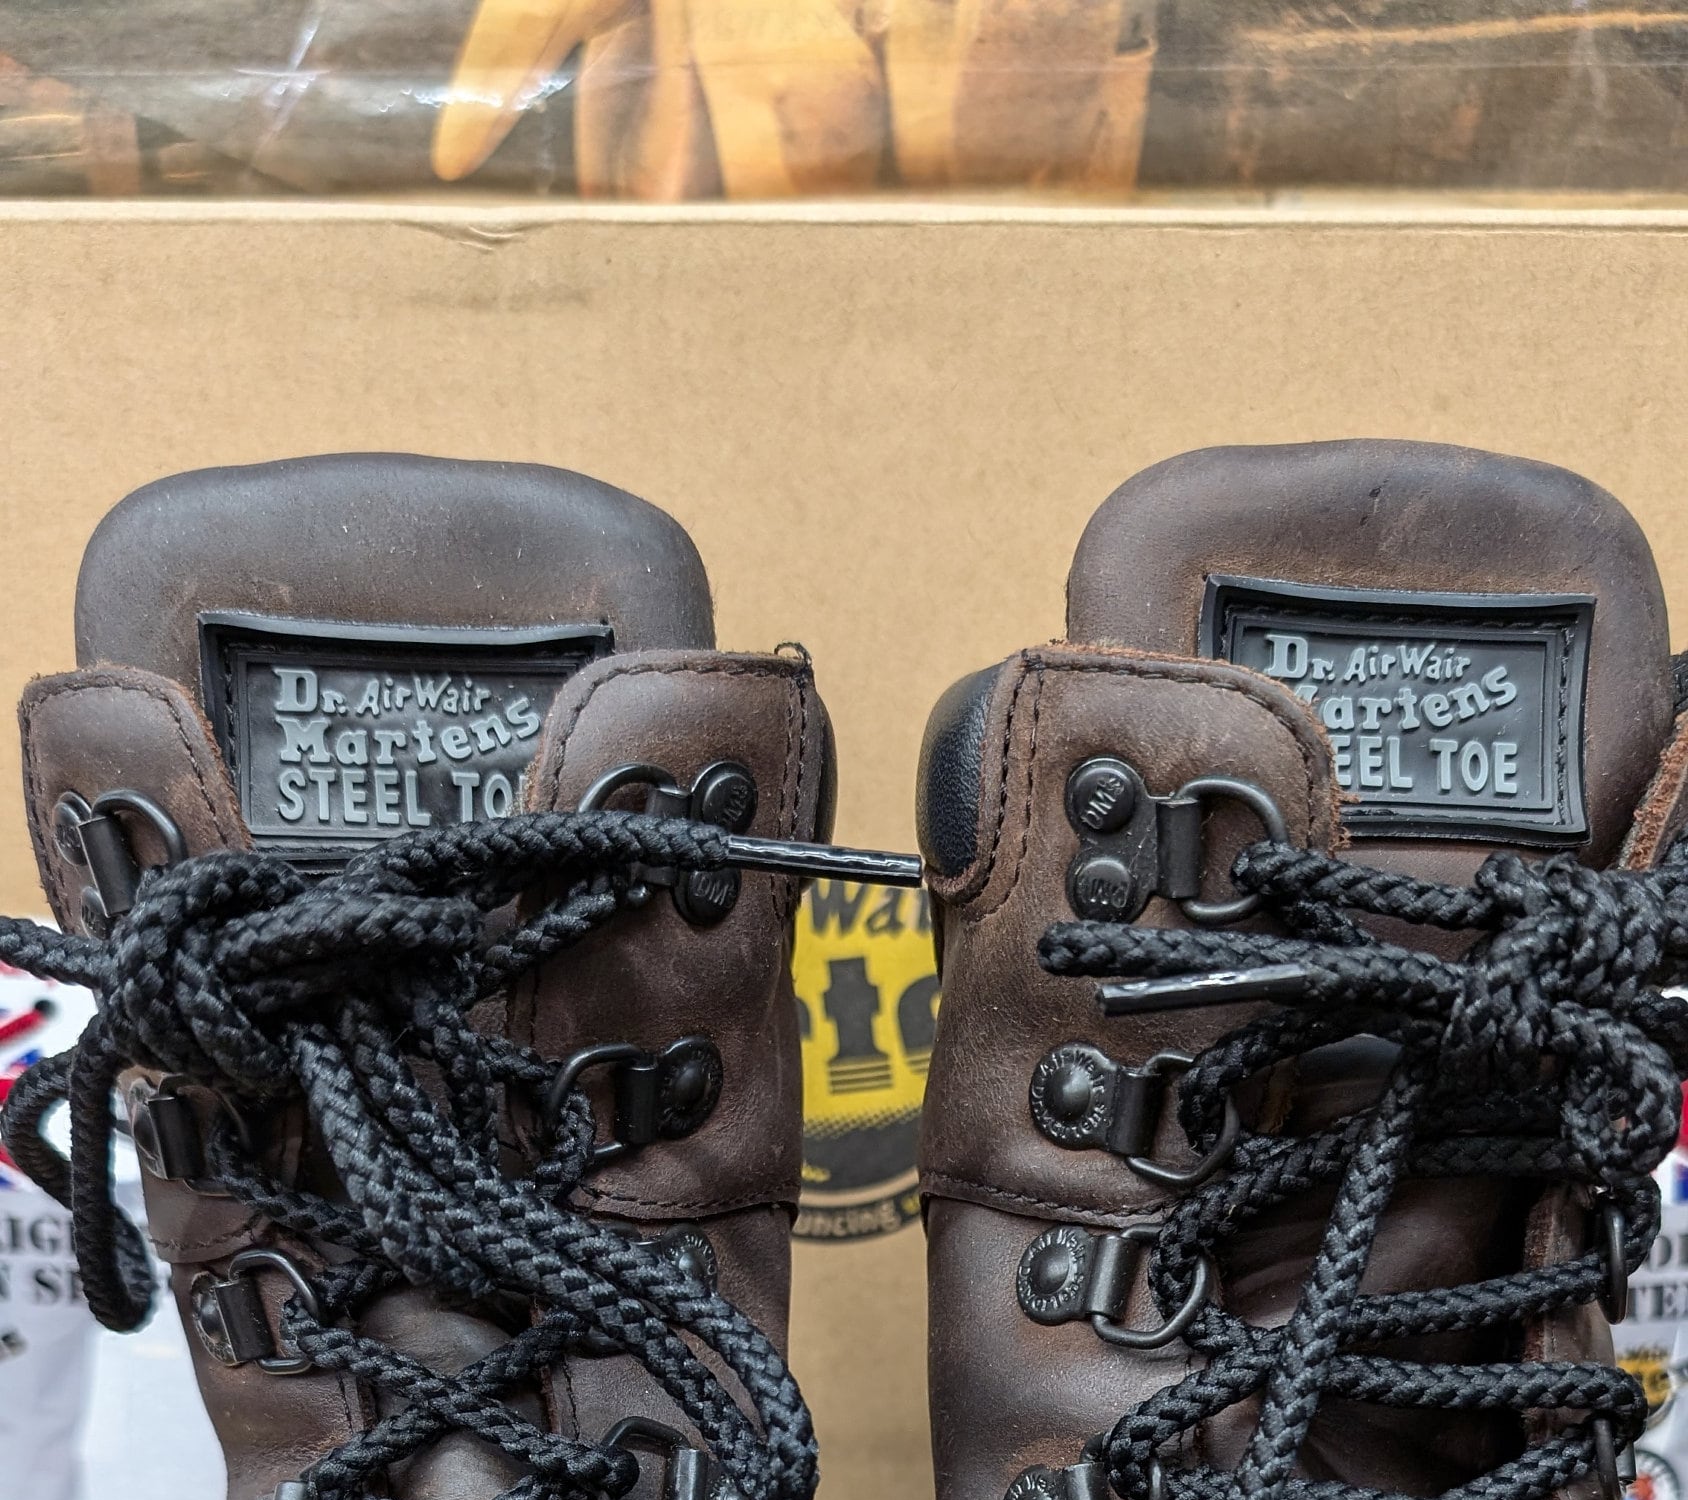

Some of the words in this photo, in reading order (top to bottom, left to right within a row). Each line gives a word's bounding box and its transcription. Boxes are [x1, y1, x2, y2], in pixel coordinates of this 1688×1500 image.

[1264, 633, 1335, 682] Dr.
[1343, 642, 1472, 684] AirWair
[272, 666, 347, 715] Dr.
[356, 674, 492, 717] AirWair
[1294, 665, 1518, 731] artens
[275, 696, 541, 766] Martens
[1331, 734, 1413, 790] EEL
[1430, 738, 1518, 795] TOE
[277, 767, 432, 827] STEEL
